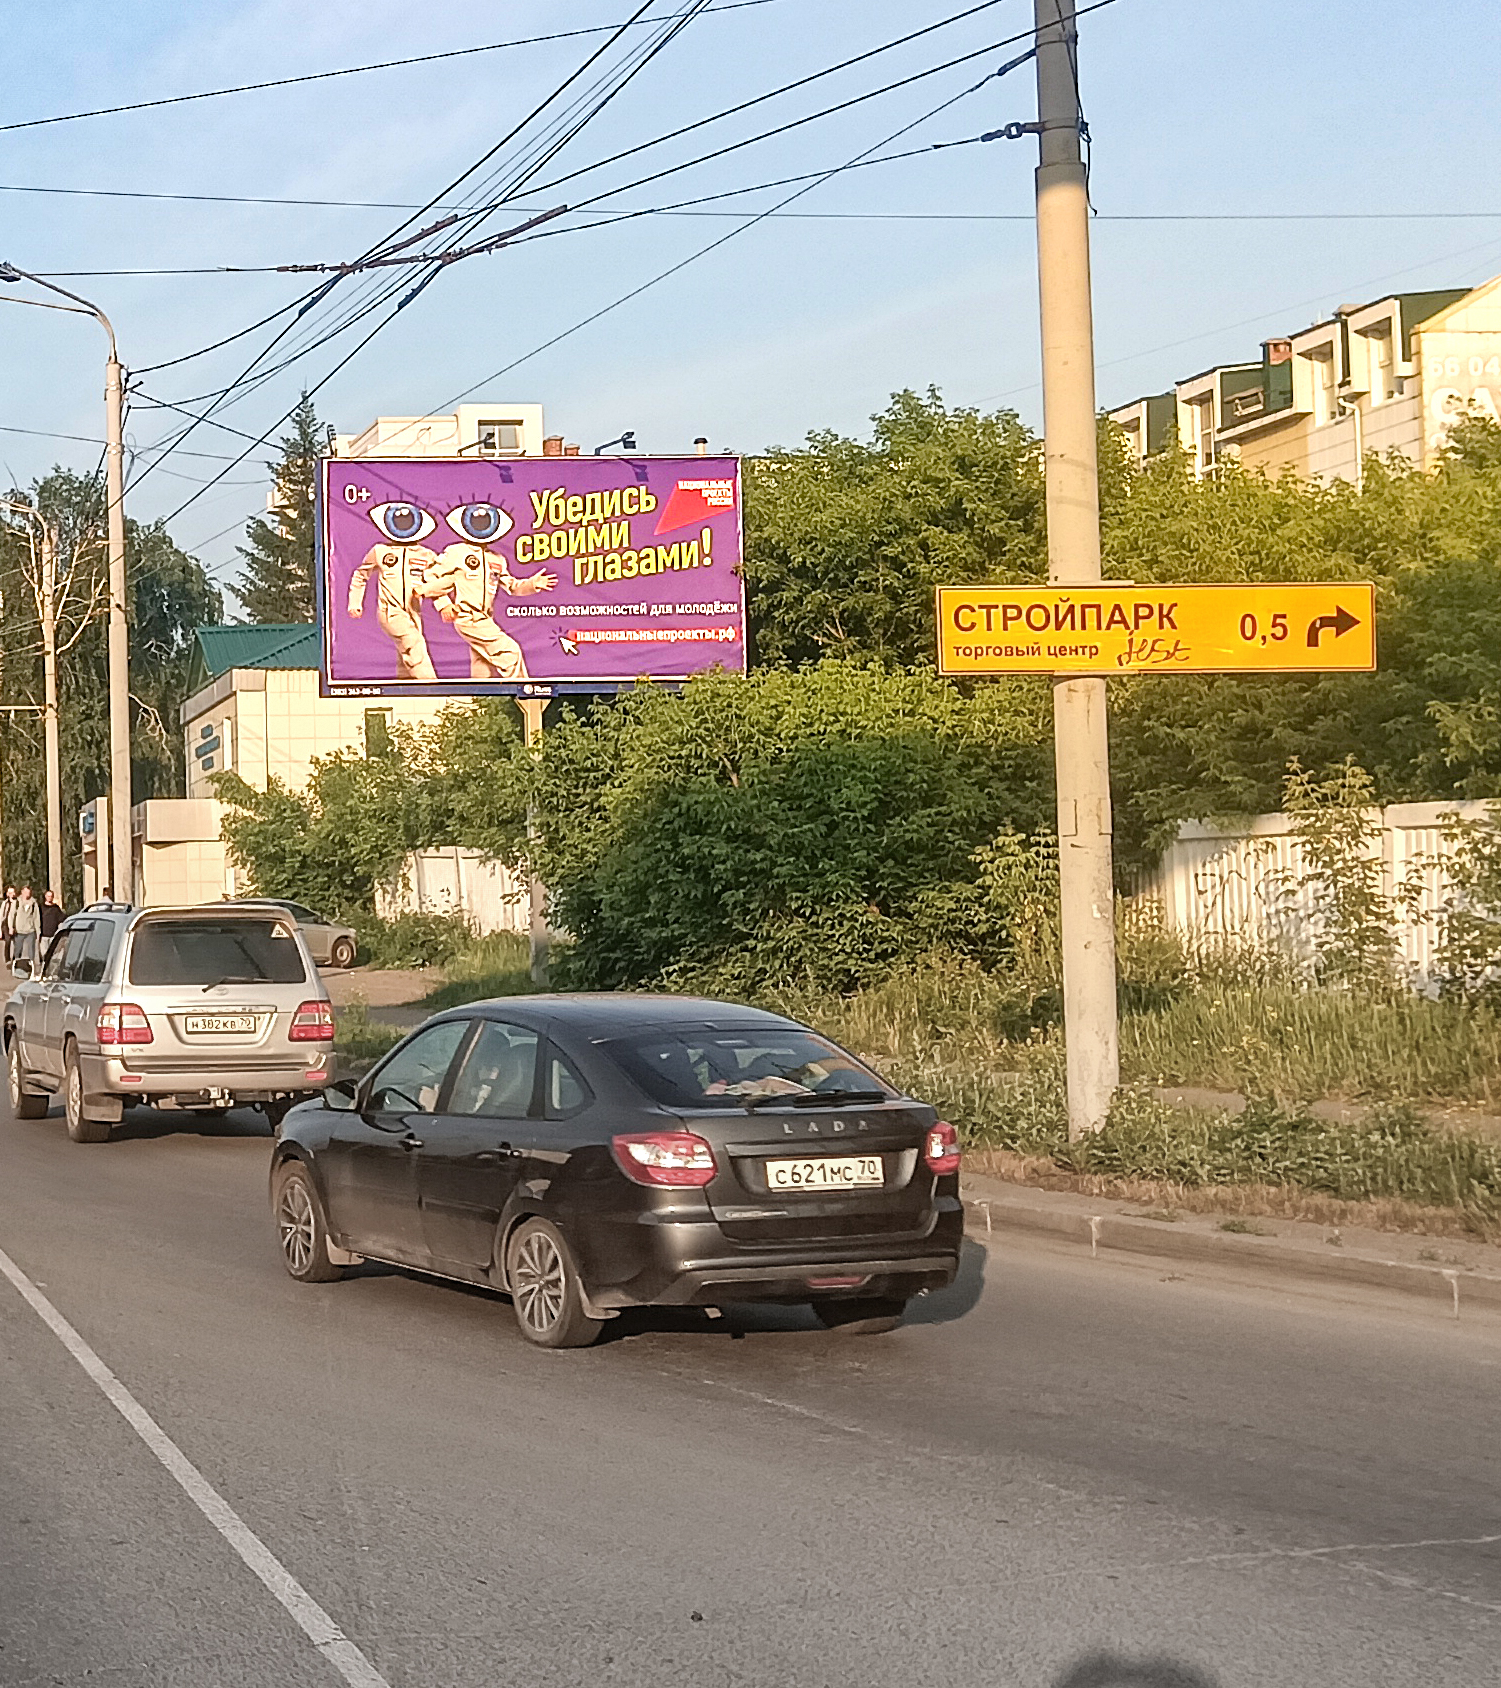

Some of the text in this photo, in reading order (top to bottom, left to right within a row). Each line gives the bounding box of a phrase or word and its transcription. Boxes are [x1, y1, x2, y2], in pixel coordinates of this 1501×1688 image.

[344, 484, 371, 504] 0+
[529, 485, 657, 529] Убедись
[516, 520, 630, 563] своими
[573, 527, 713, 586] глазами!
[506, 600, 738, 617] сколько возможностей для молодёжи
[953, 597, 1178, 632] СТРОЙПАРК
[576, 625, 736, 643] национальныепроекты.рф
[1239, 612, 1289, 647] 0,5
[952, 642, 1099, 660] торговый центр
[783, 1120, 870, 1134] LADA
[775, 1159, 877, 1185] С621МС 70
